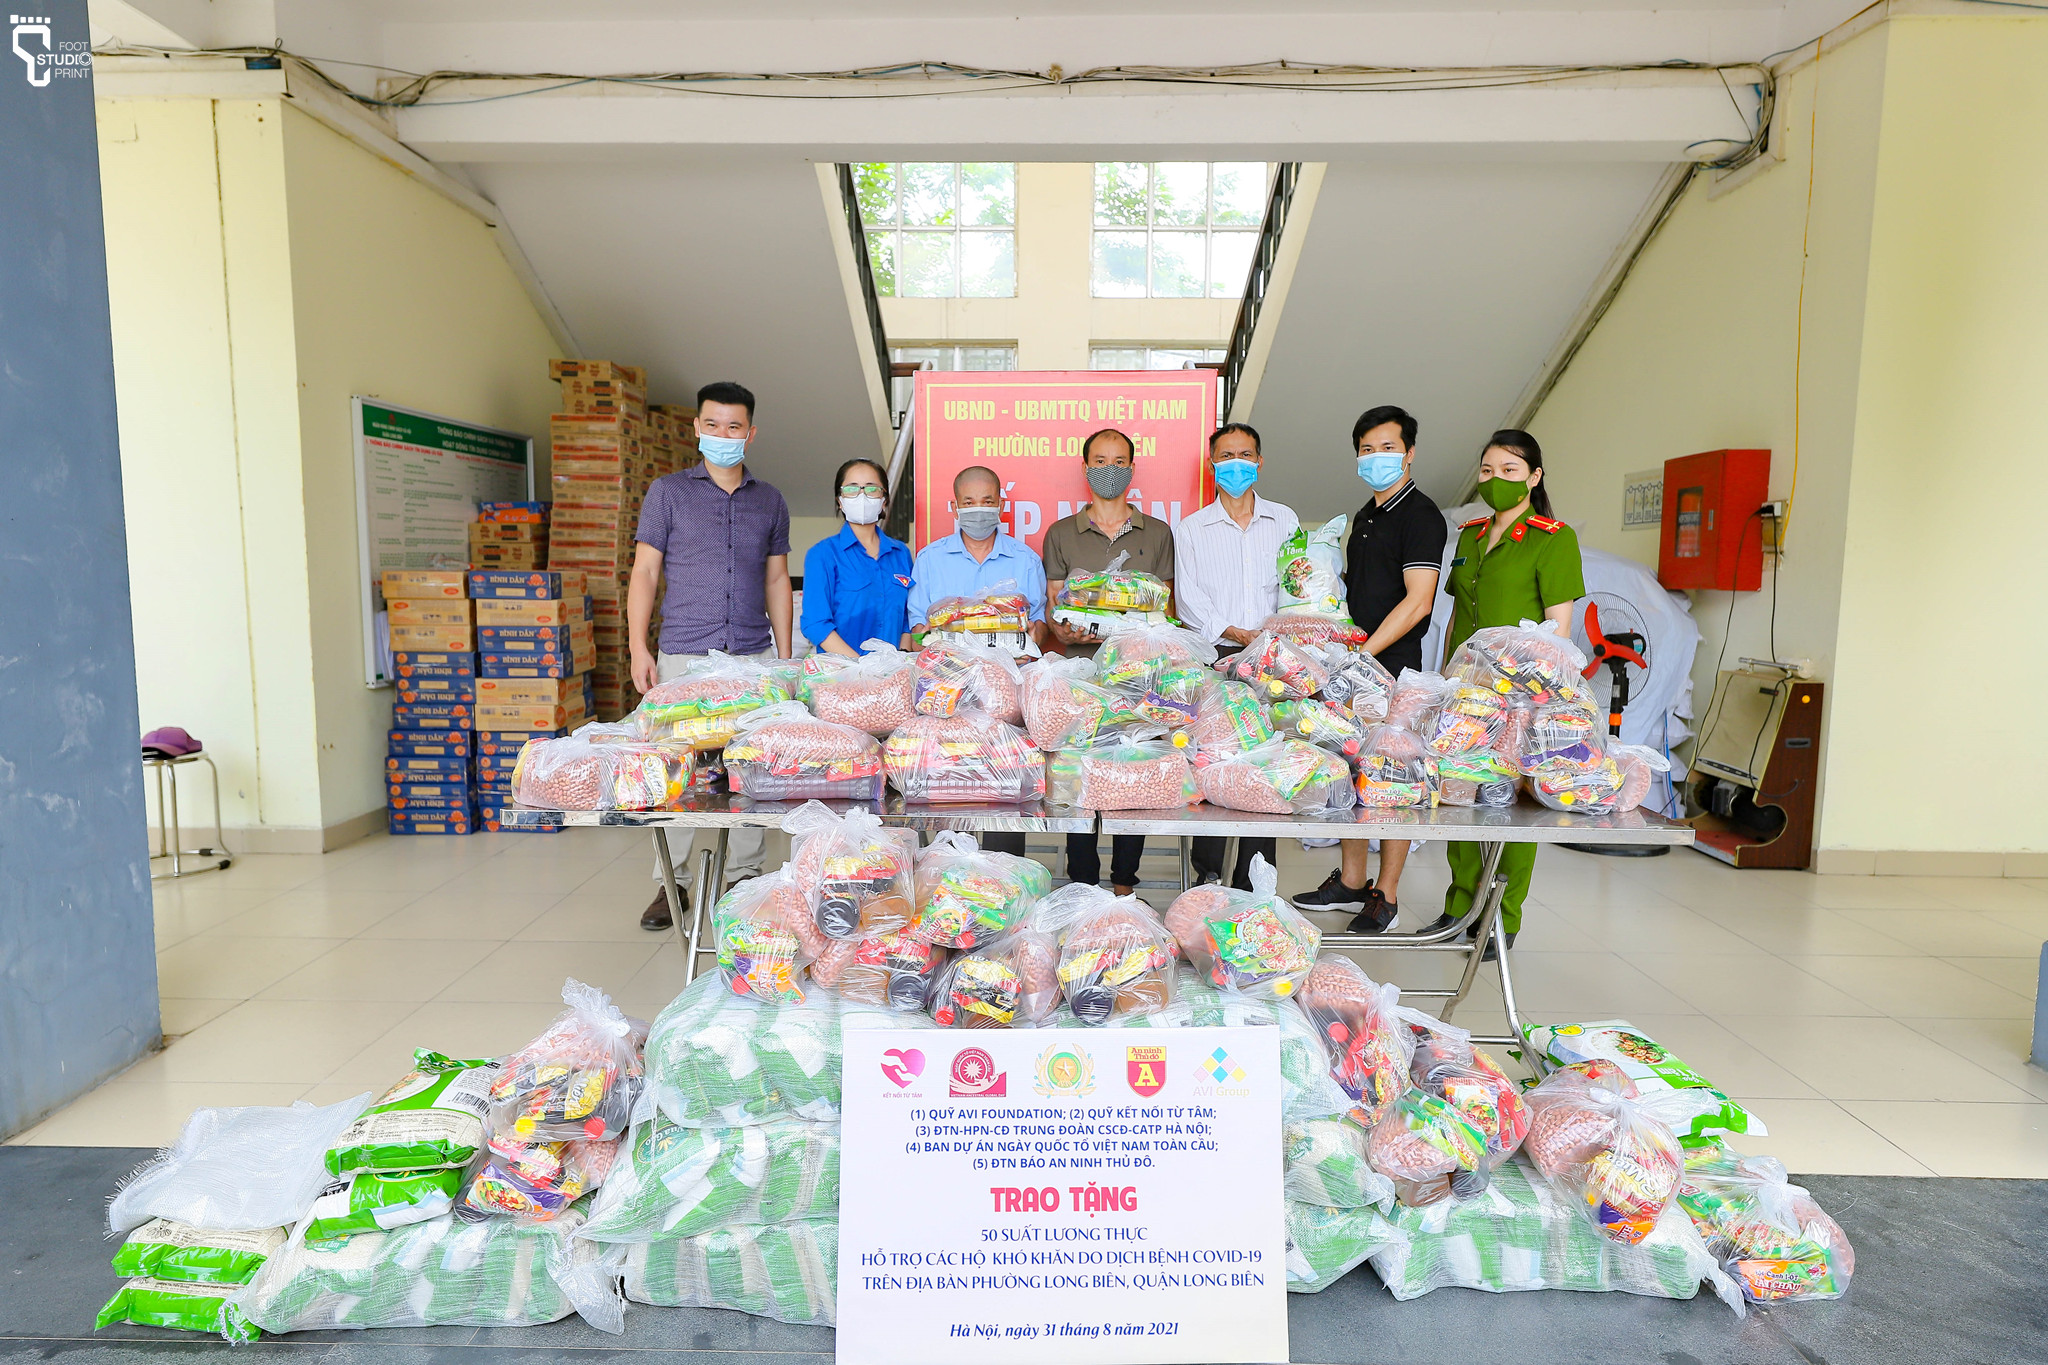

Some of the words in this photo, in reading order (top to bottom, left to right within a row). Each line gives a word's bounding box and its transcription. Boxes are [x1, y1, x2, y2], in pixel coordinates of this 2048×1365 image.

[944, 400, 996, 421] UBND
[1014, 400, 1091, 422] UBMTTQ
[1096, 395, 1136, 425] VIỆT
[1142, 399, 1187, 420] NAM
[973, 433, 1050, 457] PHƯỜNG
[1134, 1064, 1159, 1086] A
[1193, 1086, 1212, 1096] AVI
[1216, 1087, 1250, 1098] Group
[910, 1110, 926, 1120] (1)
[930, 1106, 954, 1120] QUỸ
[958, 1108, 978, 1120] AVI
[982, 1108, 1066, 1120] FOUNDATION;
[1070, 1108, 1084, 1120] (2)
[1088, 1106, 1114, 1120] QUỸ
[1116, 1106, 1138, 1118] KẾT
[1142, 1106, 1164, 1118] NỐI
[1168, 1106, 1184, 1118] TỪ
[1188, 1106, 1216, 1118] TÂM;
[916, 1126, 930, 1138] (3)
[934, 1126, 1010, 1136] ĐTN-HPN-CĐ
[1014, 1126, 1054, 1136] TRUNG
[1058, 1122, 1094, 1136] ĐOÀN
[1098, 1124, 1162, 1134] CSCĐ-CATP
[1166, 1122, 1182, 1134] HÀ
[1186, 1122, 1212, 1136] NỘI;
[906, 1142, 920, 1152] (4)
[924, 1142, 950, 1152] BAN
[954, 1142, 974, 1154] DỰ
[976, 1140, 994, 1152] ÁN
[998, 1142, 1032, 1152] NGÀY
[1034, 1140, 1070, 1154] QUỐC
[1074, 1138, 1090, 1152] TỔ
[1092, 1138, 1118, 1154] VIỆT
[1122, 1140, 1150, 1150] NAM
[1154, 1138, 1186, 1150] TOÀN
[1190, 1138, 1218, 1152] CẦU;
[974, 1158, 988, 1170] (5)
[992, 1158, 1016, 1168] ĐTN
[1020, 1156, 1046, 1168] BÁO
[1048, 1158, 1066, 1168] AN
[1070, 1158, 1102, 1168] NINH
[1106, 1154, 1130, 1168] THỦ
[1134, 1154, 1154, 1168] ĐÔ.
[990, 1186, 1060, 1212] TRAO
[1068, 1182, 1138, 1218] TẶNG
[982, 1230, 998, 1242] 50
[1002, 1224, 1040, 1242] SUẤT
[1046, 1228, 1100, 1240] LƯƠNG
[1104, 1228, 1147, 1244] THỰC
[861, 1248, 887, 1266] HỖ
[890, 1250, 922, 1269] TRỢ
[924, 1246, 958, 1266] CÁC
[961, 1248, 986, 1269] HỘ
[992, 1247, 1028, 1266] KHÓ
[1031, 1247, 1075, 1266] KHĂN
[1078, 1250, 1102, 1265] DO
[1106, 1250, 1145, 1268] DỊCH
[1148, 1248, 1189, 1266] BỆNH
[1192, 1250, 1262, 1264] COVID-19
[862, 1272, 902, 1290] TRÊN
[906, 1275, 933, 1292] ĐỊA
[937, 1272, 968, 1290] BÀN
[972, 1270, 1040, 1290] PHƯỜNG
[1044, 1275, 1090, 1290] LONG
[1092, 1272, 1131, 1291] BIÊN,
[1133, 1270, 1181, 1292] QUẬN
[1184, 1274, 1228, 1288] LONG
[1231, 1270, 1265, 1288] BIÊN
[950, 1324, 970, 1336] Hà
[974, 1324, 1000, 1340] Nội,
[1006, 1324, 1040, 1340] ngày
[1044, 1324, 1056, 1336] 31
[1060, 1322, 1100, 1340] tháng
[1102, 1324, 1112, 1336] 8
[1114, 1324, 1144, 1336] năm
[1148, 1322, 1178, 1336] 2021
